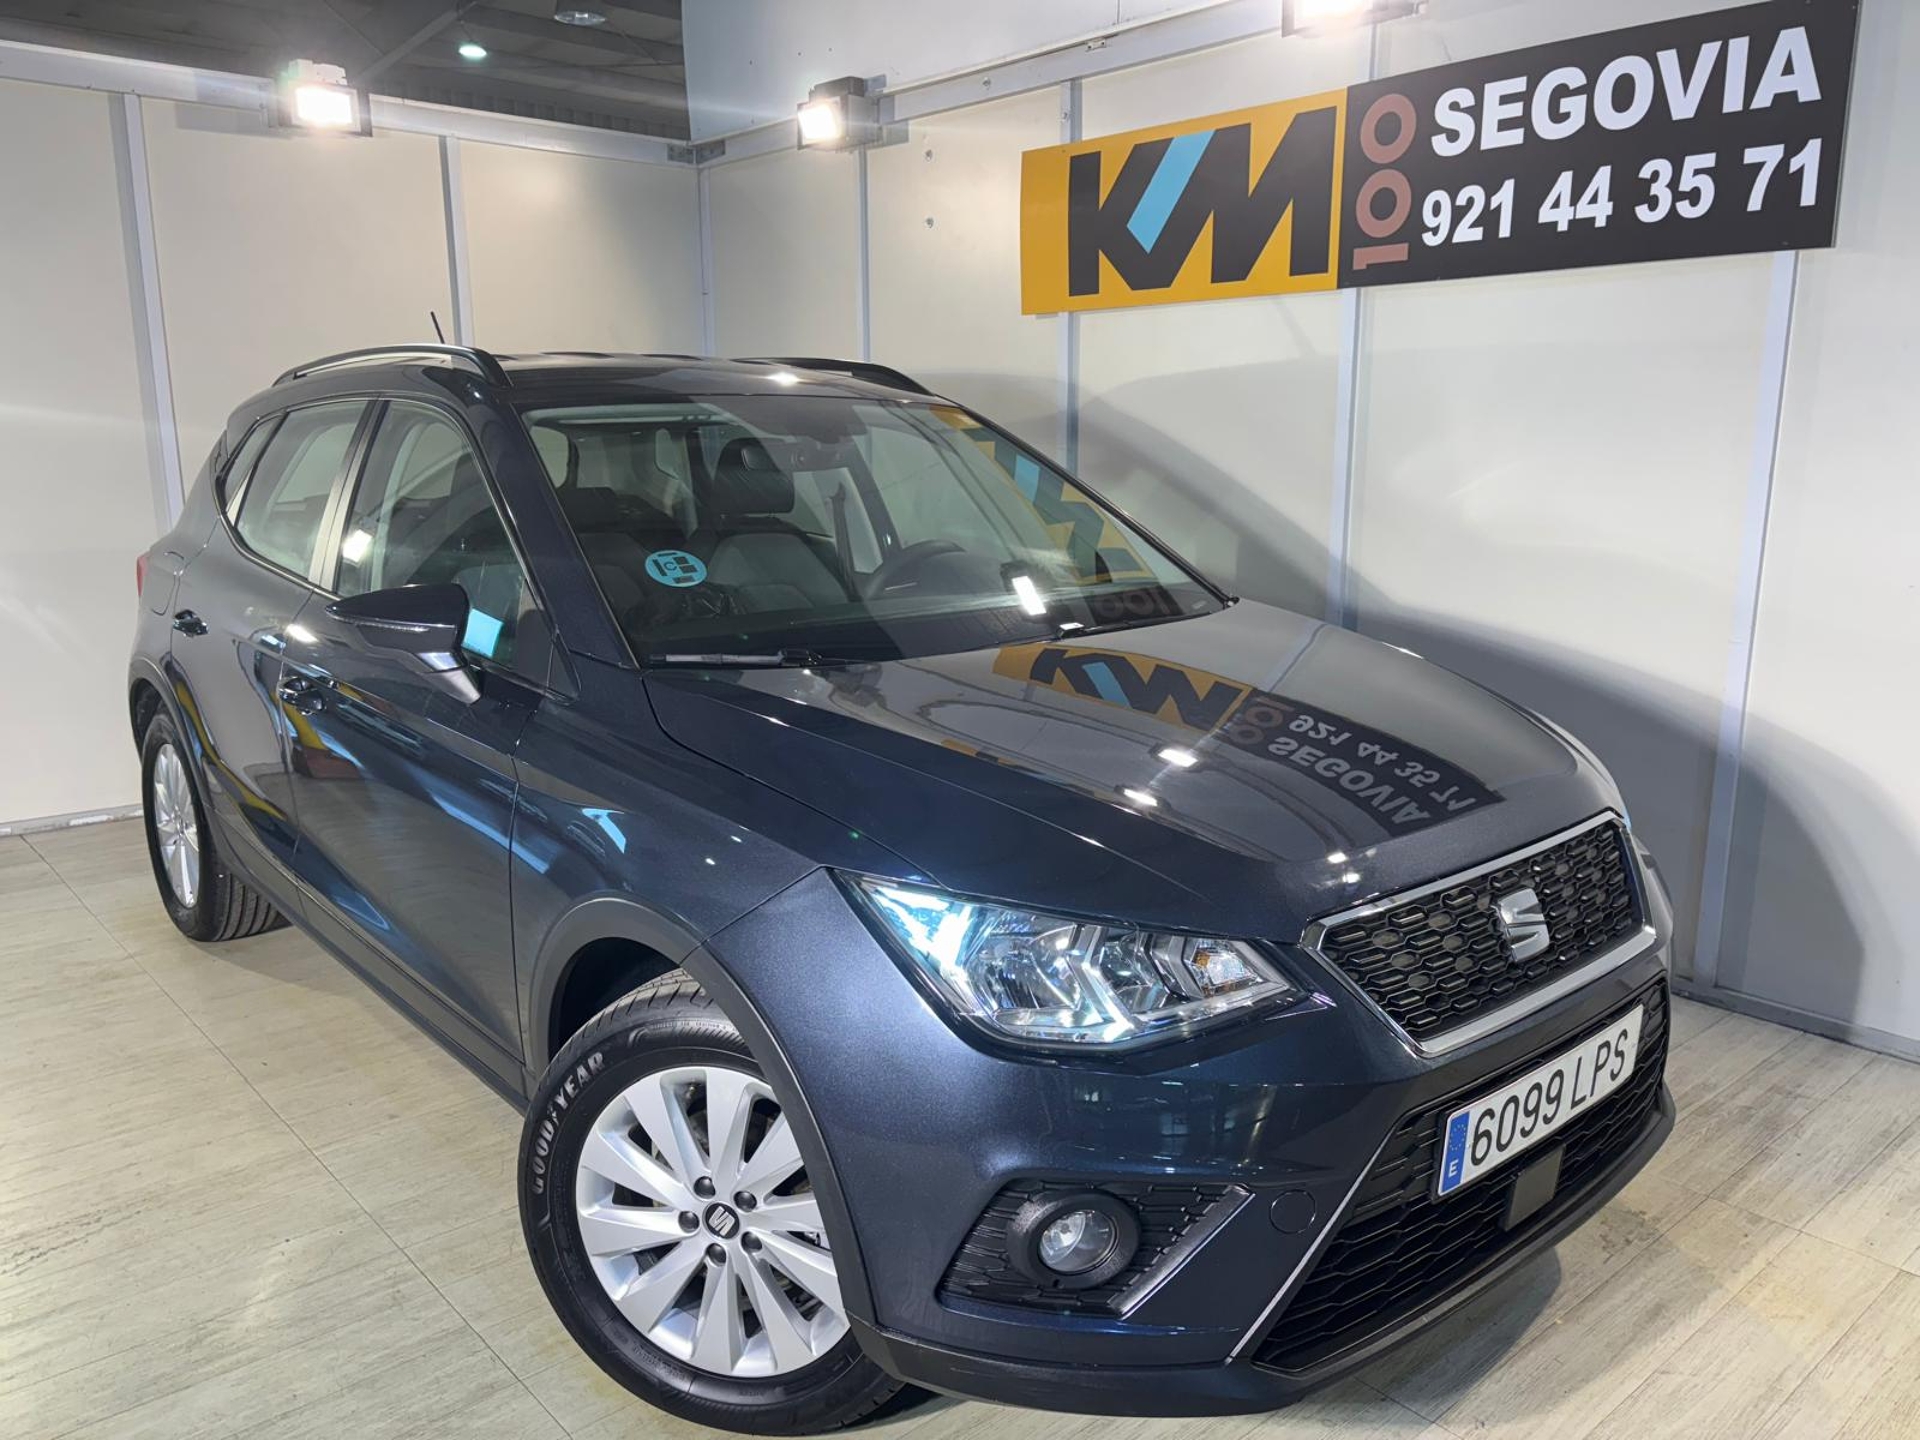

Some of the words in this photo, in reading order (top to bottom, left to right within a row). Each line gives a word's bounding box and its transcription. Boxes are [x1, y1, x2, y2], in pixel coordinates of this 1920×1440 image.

[1431, 26, 1822, 157] SEGOVIA
[1068, 105, 1338, 296] KM
[1353, 94, 1417, 269] 100
[1421, 178, 1515, 247] 921
[1538, 165, 1613, 233] 44
[1635, 152, 1717, 223] 35
[1743, 138, 1822, 212] 71
[1470, 1068, 1565, 1167] 6099
[1570, 1028, 1628, 1111] LPS
[1448, 1159, 1459, 1177] E
